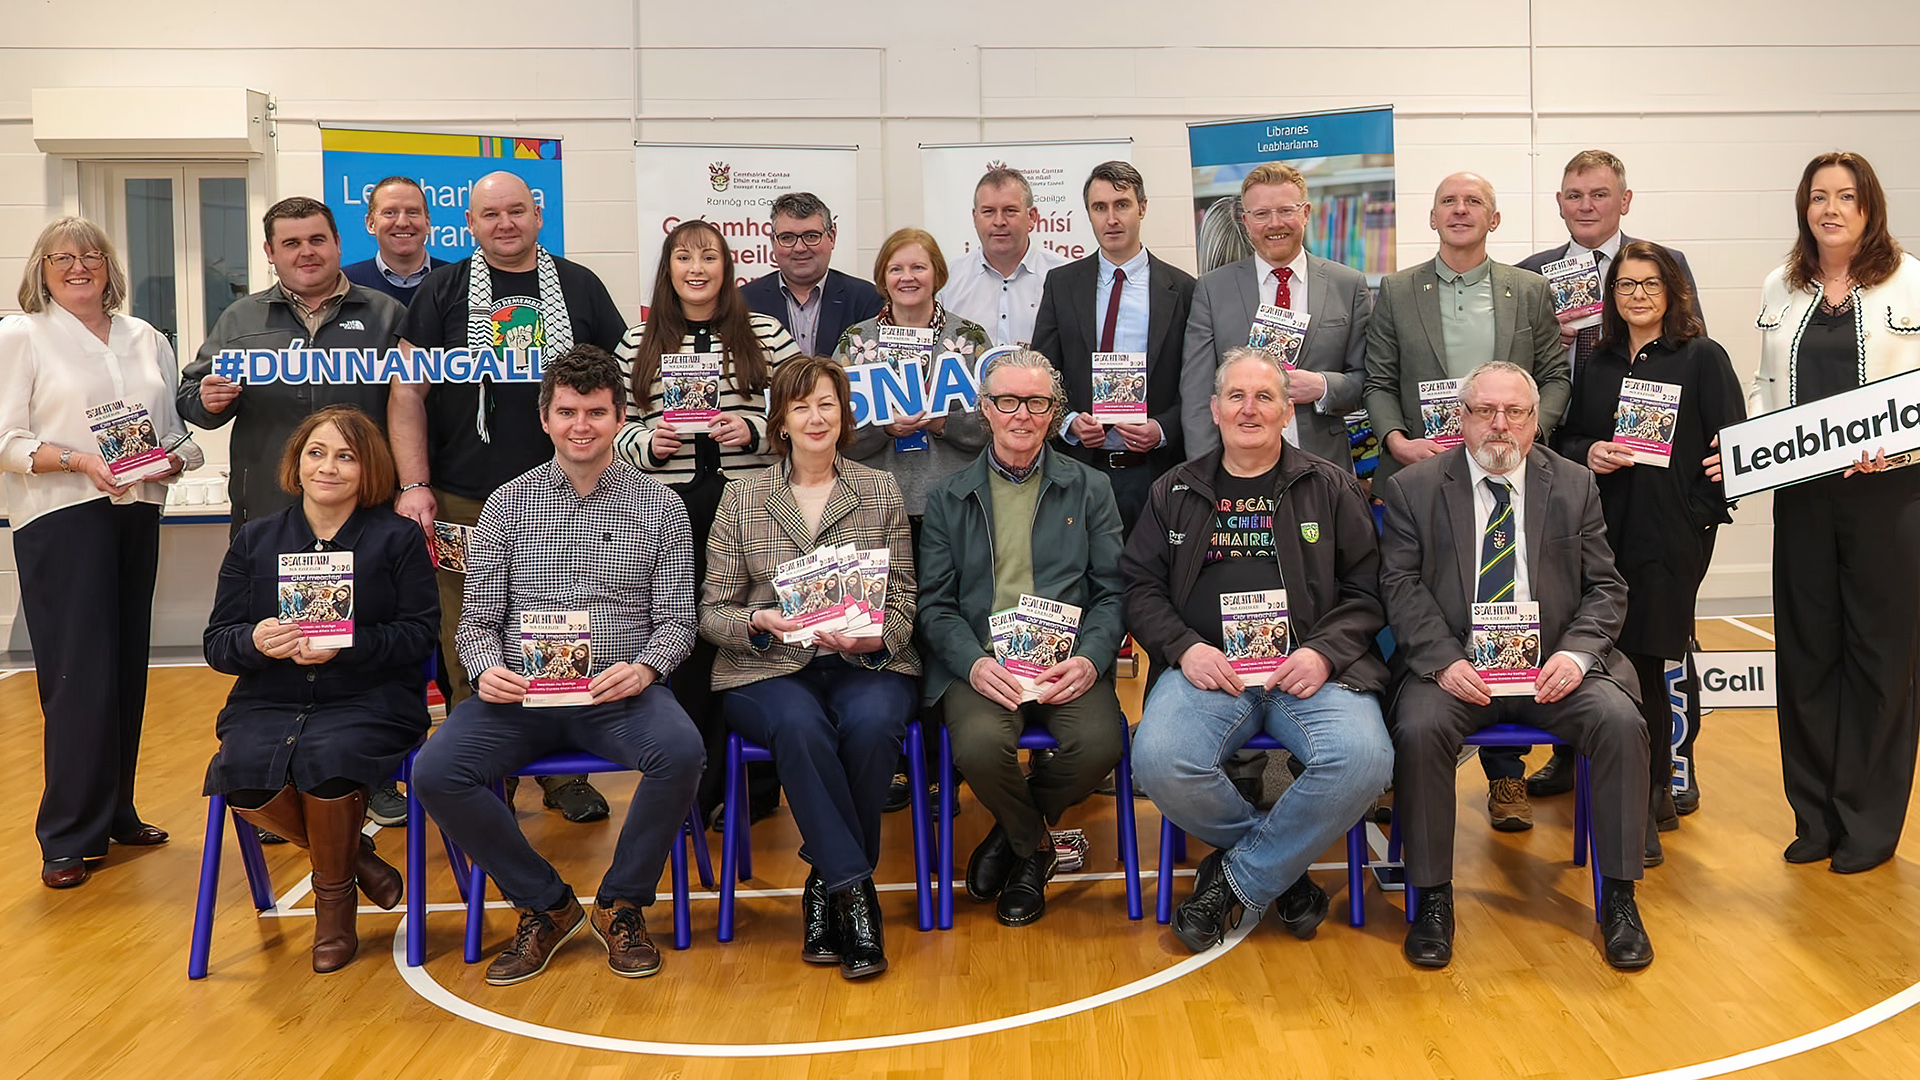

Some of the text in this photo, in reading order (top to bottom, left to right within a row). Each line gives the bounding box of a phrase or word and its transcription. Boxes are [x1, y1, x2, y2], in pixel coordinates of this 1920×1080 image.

[1266, 124, 1309, 137] Libraries
[1258, 139, 1319, 152] Leabharlanna
[707, 197, 742, 207] Rannóg
[215, 341, 546, 382] #DÚNNANGALL
[1235, 496, 1275, 512] SCÁT
[1227, 513, 1273, 528] CHÉIL
[1700, 666, 1765, 692] Gall
